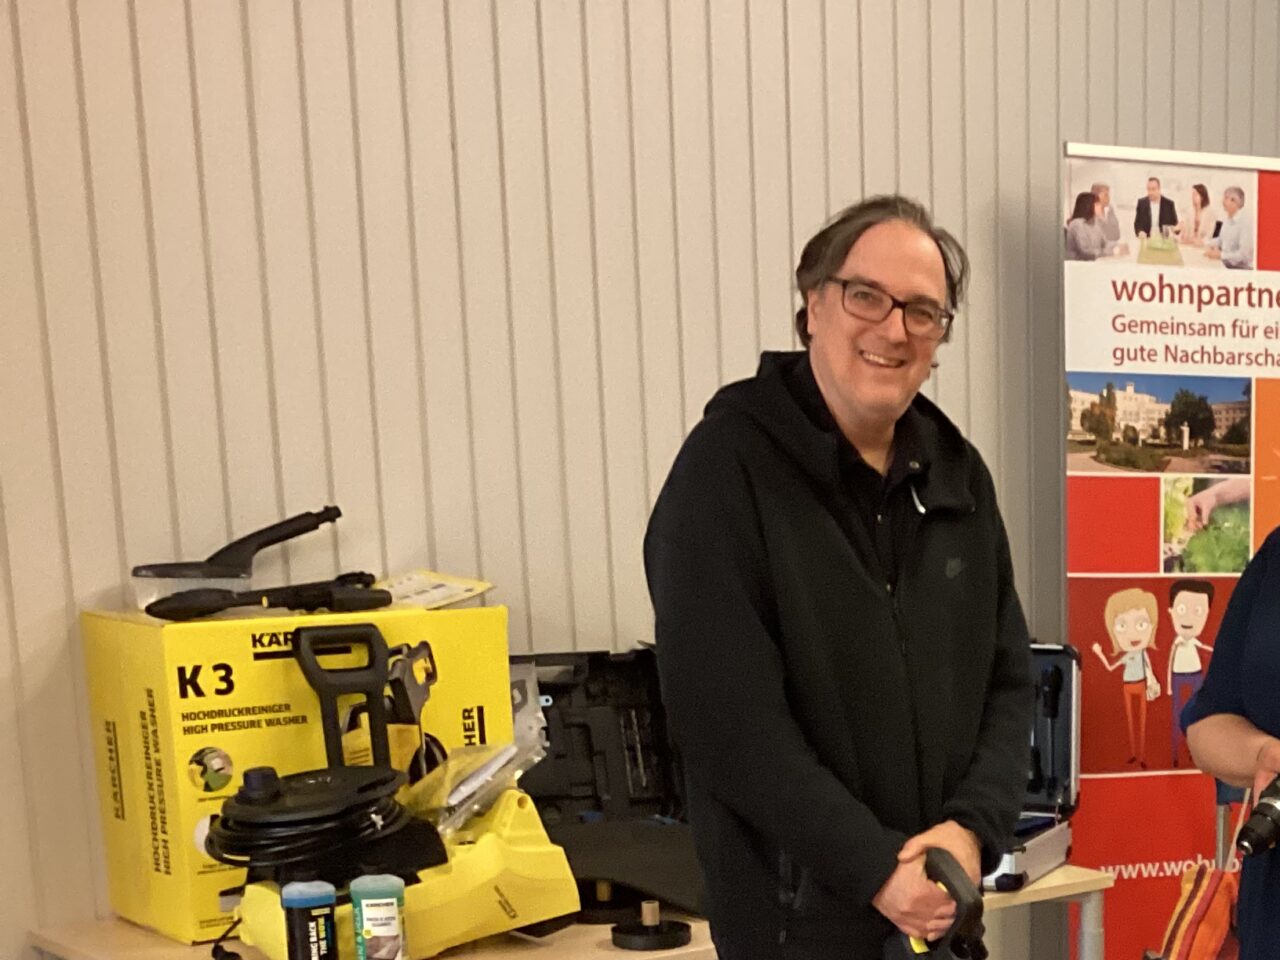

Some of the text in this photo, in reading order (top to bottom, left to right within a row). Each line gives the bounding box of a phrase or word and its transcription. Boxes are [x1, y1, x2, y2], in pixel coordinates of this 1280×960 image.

[1111, 314, 1225, 338] Gemeinsam
[1231, 319, 1258, 339] für
[1112, 345, 1158, 366] gute
[252, 631, 295, 649] KÄR
[177, 663, 235, 699] K 3
[181, 703, 291, 722] HOCHDRUCKREINIGER
[183, 715, 308, 736] HIGH PRESSURE WASHER
[462, 707, 476, 746] HER
[140, 710, 162, 873] HOCHDRUCKREINIGER
[146, 688, 172, 876] HIGH PRESSURE WASHER
